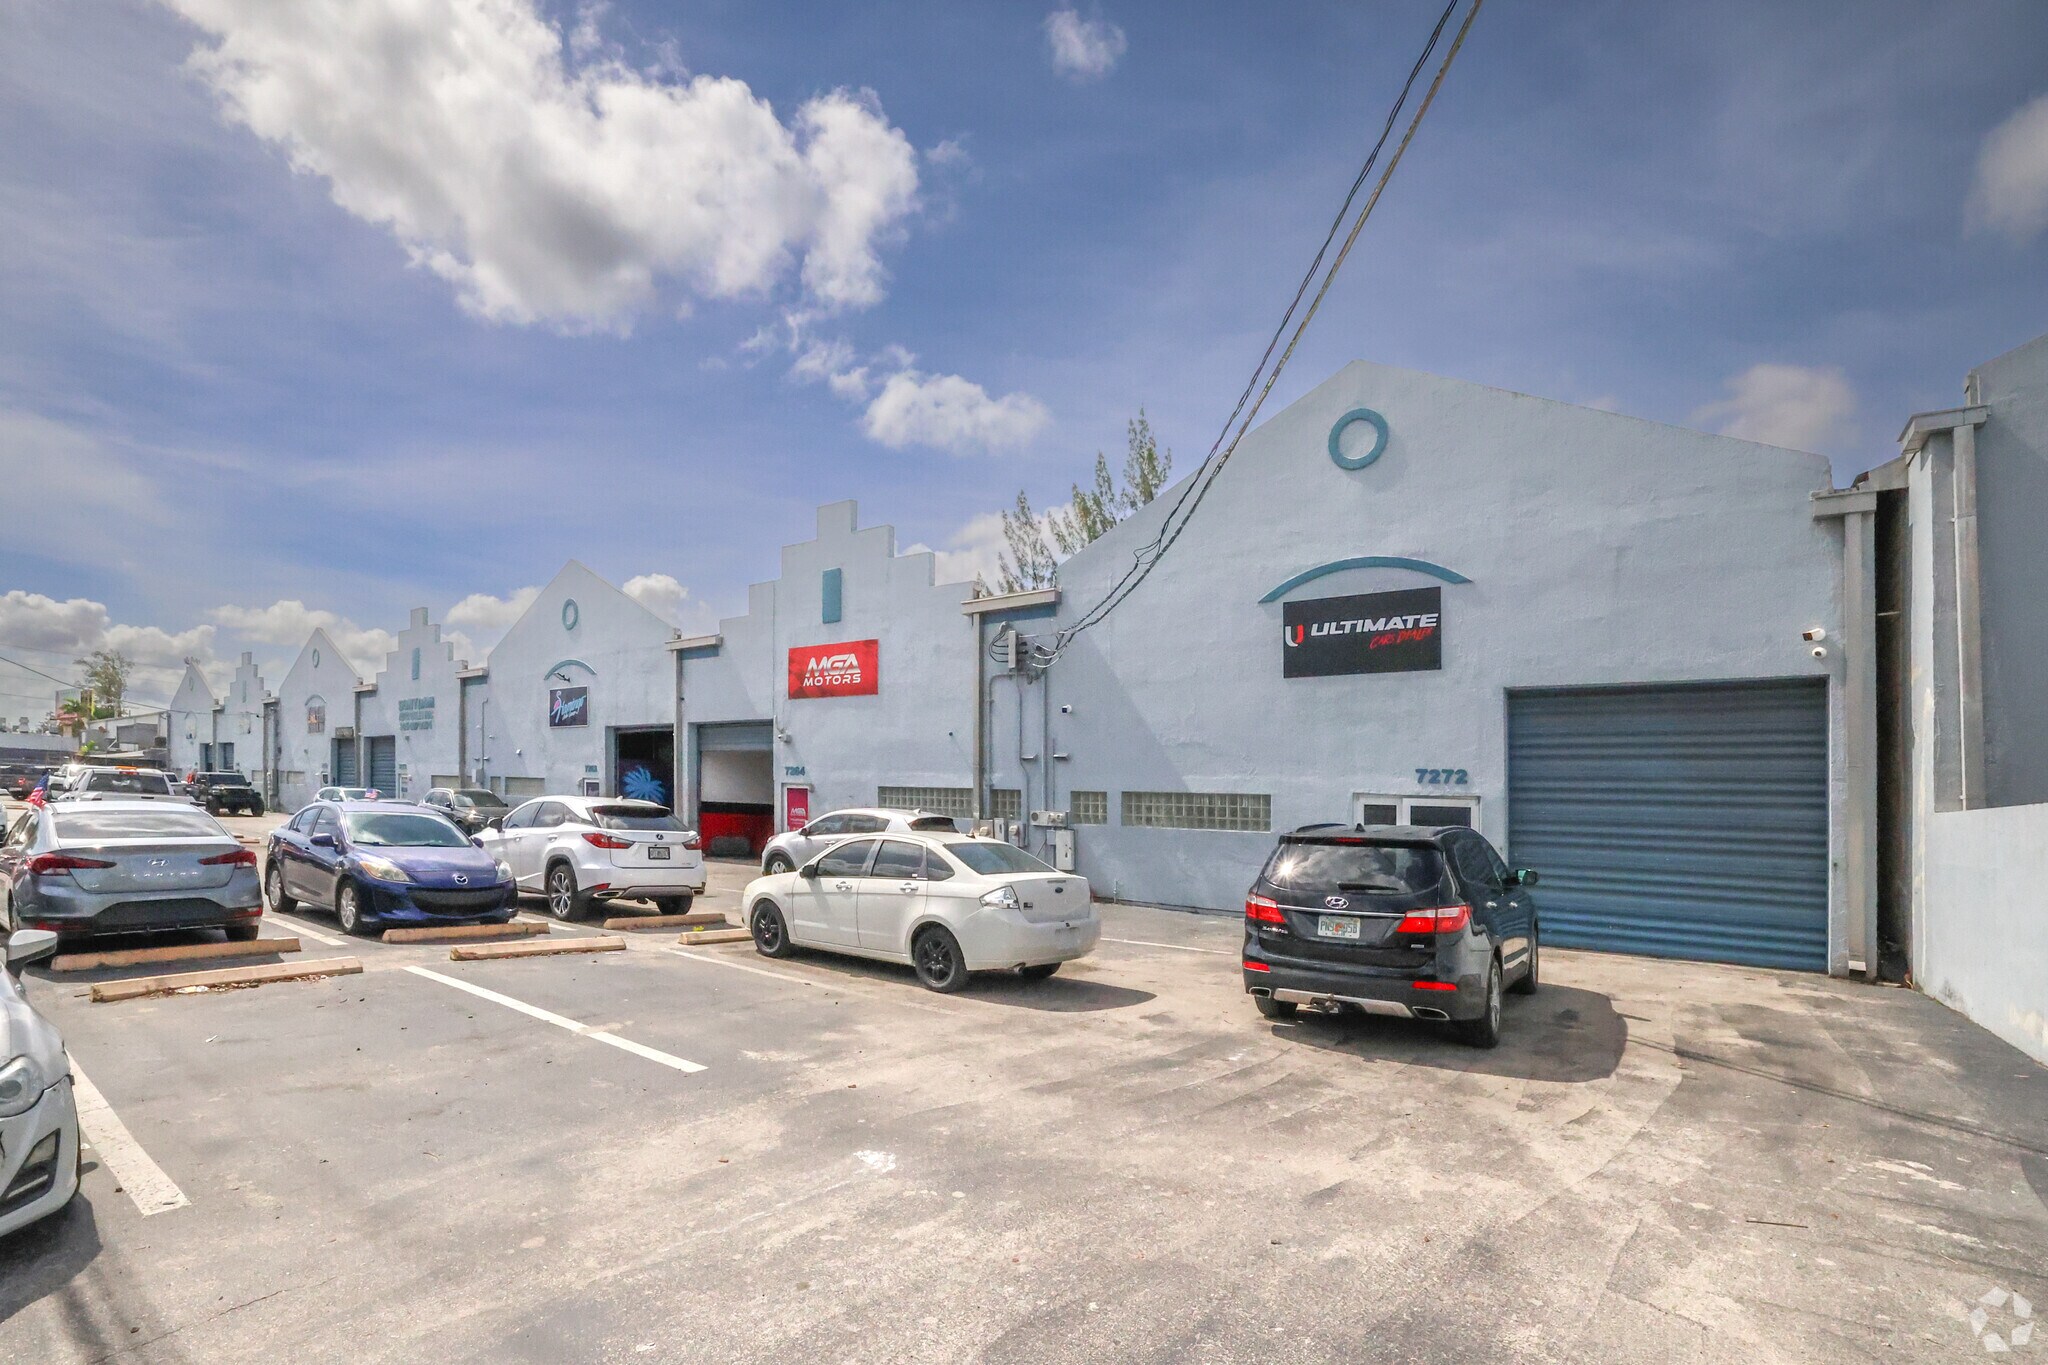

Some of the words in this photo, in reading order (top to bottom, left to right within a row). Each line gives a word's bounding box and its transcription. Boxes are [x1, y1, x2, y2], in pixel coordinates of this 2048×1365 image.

[1311, 613, 1439, 636] ULTIMATE
[805, 653, 861, 677] MGA
[803, 673, 861, 687] MOTORS
[1415, 768, 1468, 785] 7272
